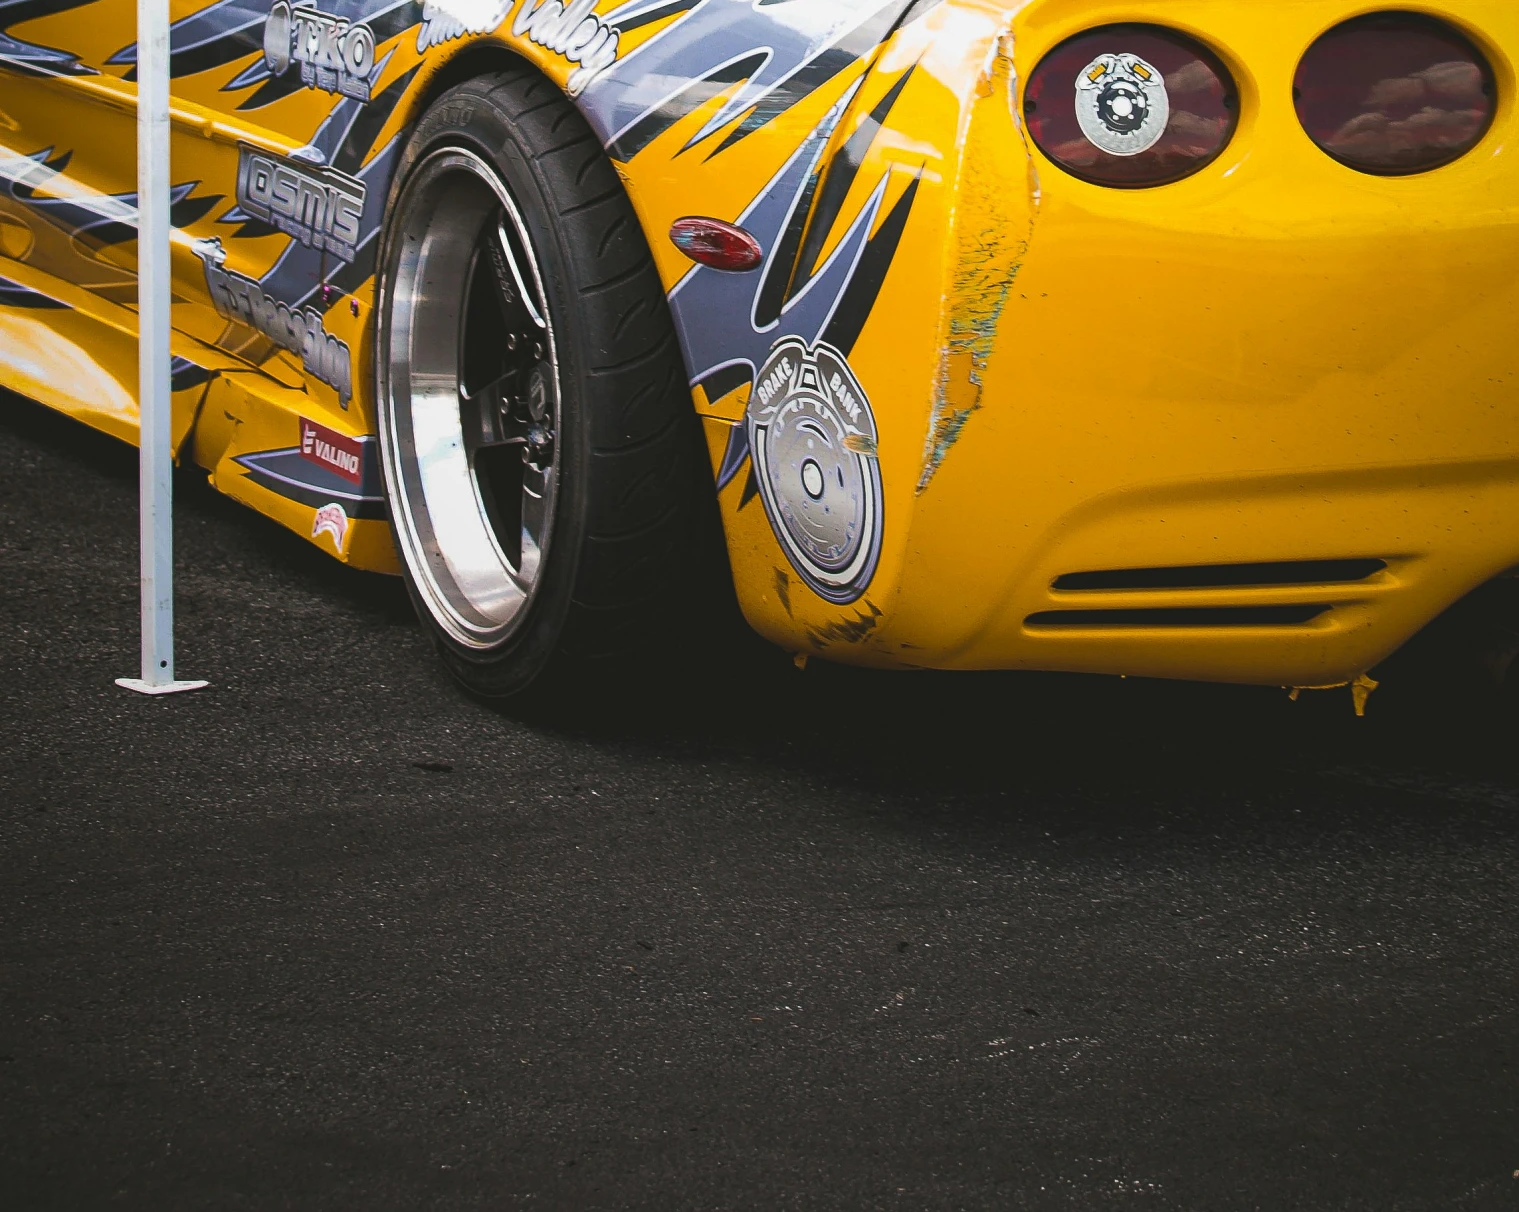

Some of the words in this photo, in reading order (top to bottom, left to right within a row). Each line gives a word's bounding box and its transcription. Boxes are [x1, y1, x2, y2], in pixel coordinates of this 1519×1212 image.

[292, 9, 375, 79] TKO
[236, 140, 367, 248] COSMIS
[757, 356, 793, 406] BRAKE
[829, 371, 863, 424] BANK
[315, 438, 360, 475] VALINO
